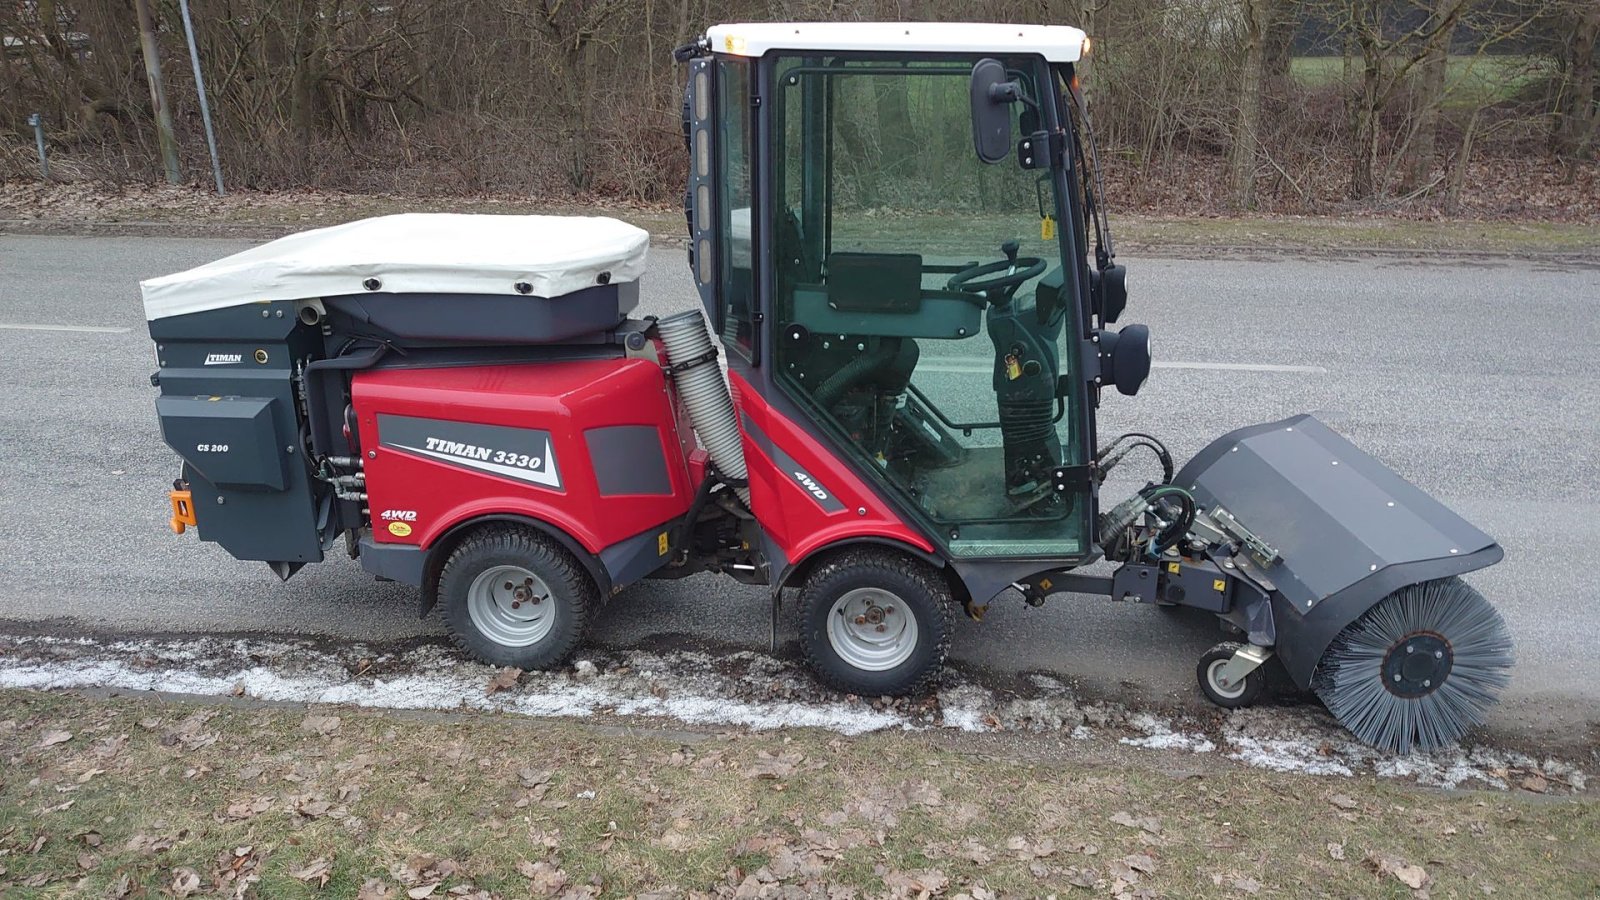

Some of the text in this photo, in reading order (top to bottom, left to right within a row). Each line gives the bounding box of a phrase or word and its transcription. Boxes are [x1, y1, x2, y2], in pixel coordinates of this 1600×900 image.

[210, 354, 242, 362] TIMAN
[197, 444, 229, 452] CS 200
[426, 437, 541, 469] TIMAN 3330
[794, 471, 828, 500] 4WD
[380, 509, 417, 519] 4WD
